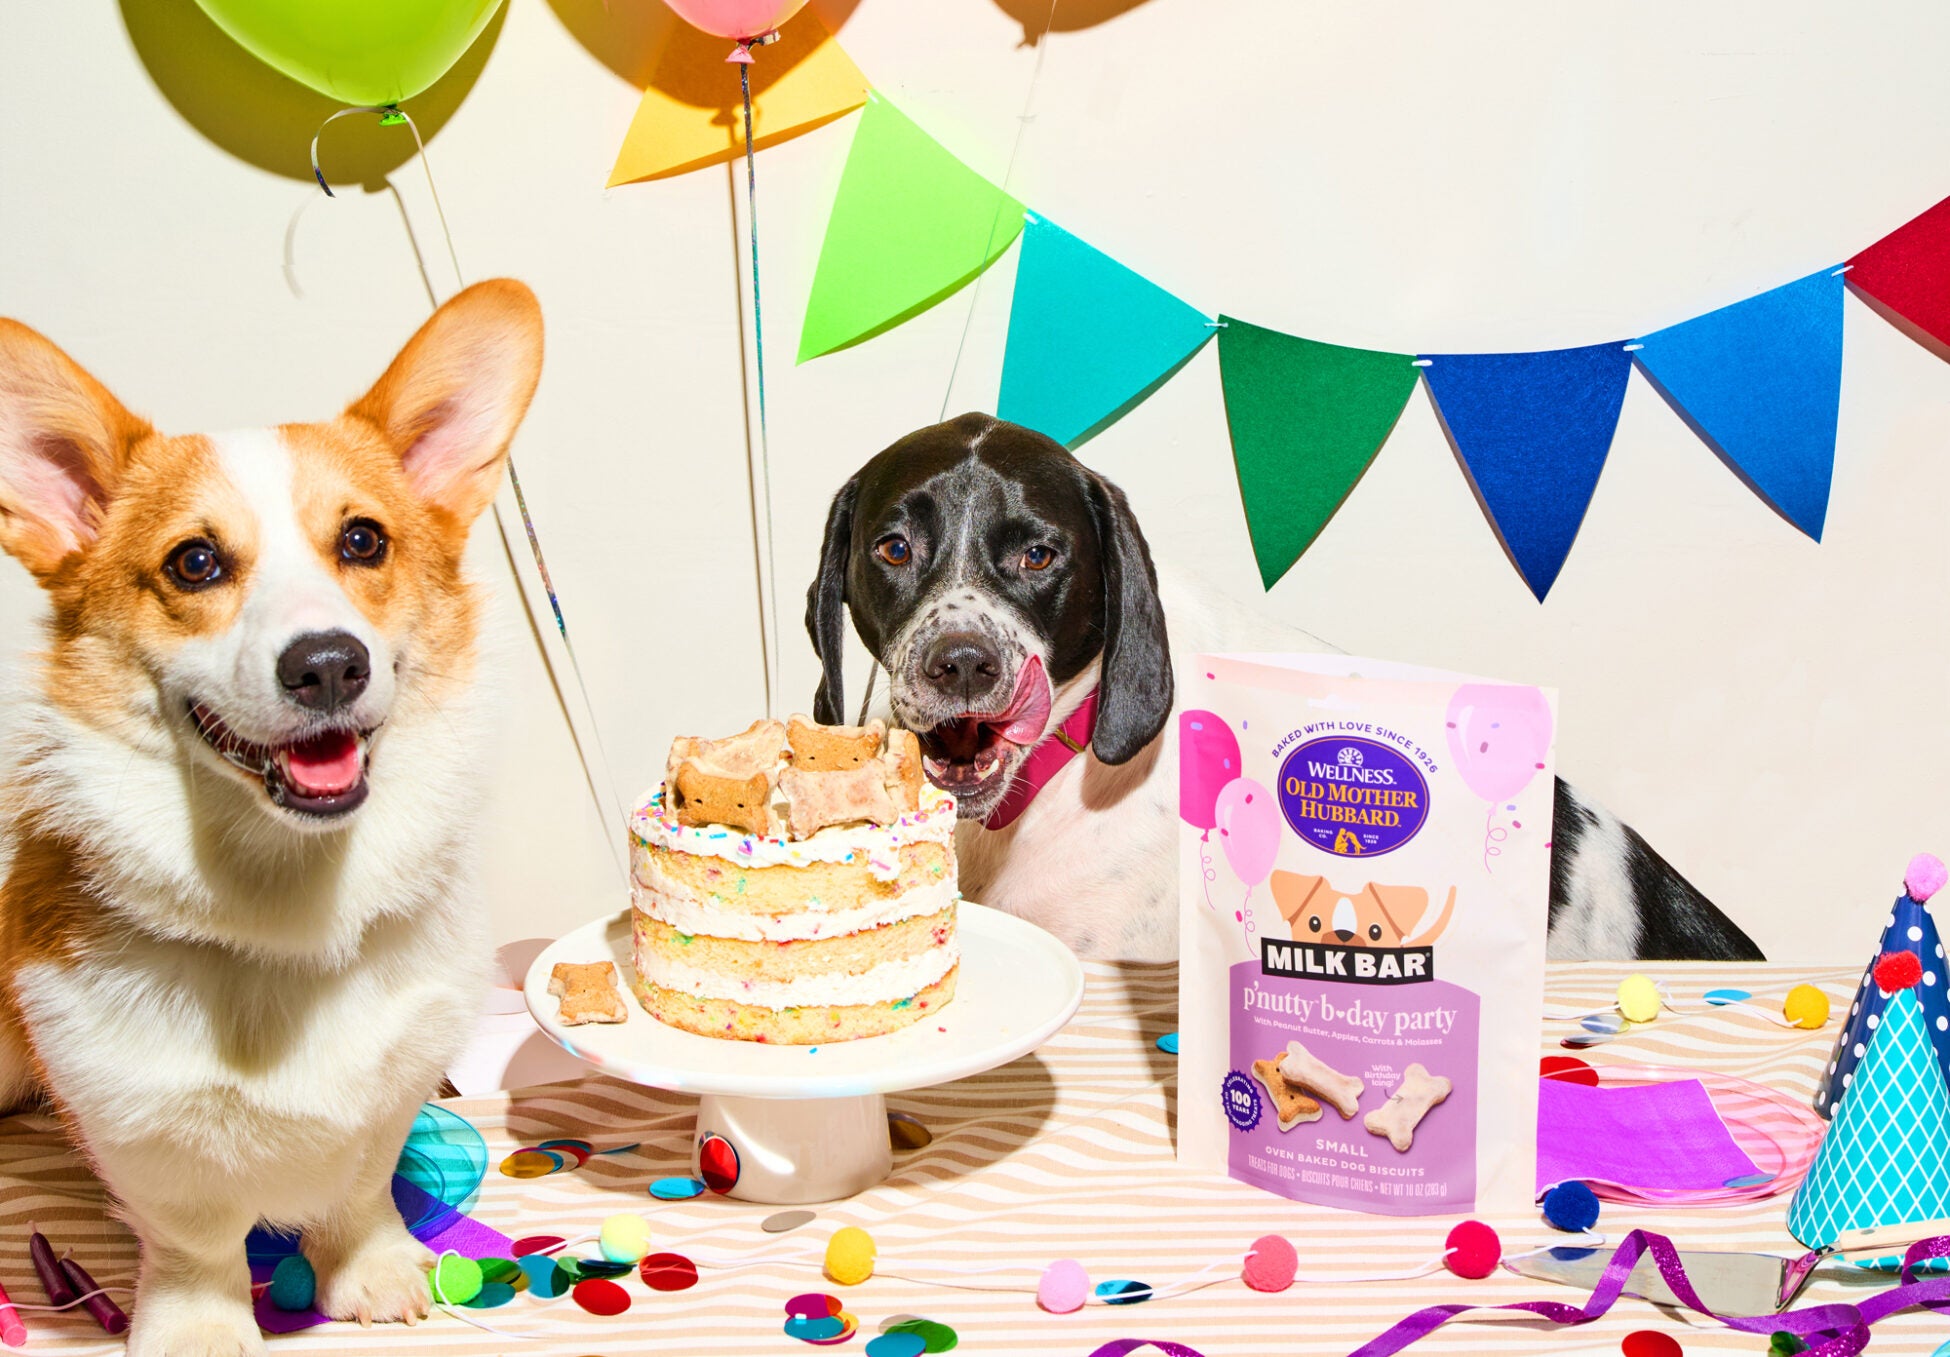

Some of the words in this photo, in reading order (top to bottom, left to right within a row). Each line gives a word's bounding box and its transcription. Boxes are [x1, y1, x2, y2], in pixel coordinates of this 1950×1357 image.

[1272, 729, 1302, 757] BAKED
[1304, 722, 1335, 734] WITH
[1339, 722, 1372, 732] LOVE
[1376, 727, 1413, 749] SINCE
[1414, 747, 1438, 773] 1926
[1286, 777, 1324, 798] OLD
[1327, 783, 1418, 808] MOTHER
[1300, 800, 1399, 827] HUBBARD
[1267, 945, 1348, 975] MILK
[1254, 1016, 1272, 1026] With
[1273, 1021, 1301, 1031] Peanut
[1303, 1026, 1331, 1038] Butter,
[1332, 1031, 1361, 1043] Apples,
[1363, 1036, 1395, 1046] Carrots
[1405, 1038, 1442, 1046] Molasses
[1394, 1006, 1458, 1036] party
[1227, 1076, 1253, 1094] CELEBRATING
[1364, 1071, 1401, 1081] Birthday
[1230, 1089, 1251, 1107] 100
[1232, 1104, 1250, 1114] YEARS
[1265, 1146, 1294, 1160] OVEN
[1298, 1154, 1338, 1167] BAKED
[1341, 1161, 1365, 1172] DOG
[1370, 1166, 1425, 1176] BISCUITS
[1316, 1139, 1368, 1158] SMALL
[1248, 1155, 1266, 1172] TREATS
[1267, 1161, 1278, 1175] FOR
[1279, 1165, 1295, 1180] DOGS
[1301, 1170, 1330, 1186] BISCUITS
[1332, 1175, 1349, 1188] POUR
[1350, 1178, 1373, 1192] CHIENS
[1380, 1182, 1392, 1195] NET
[1393, 1184, 1405, 1196] WT
[1415, 1184, 1424, 1196] OZ
